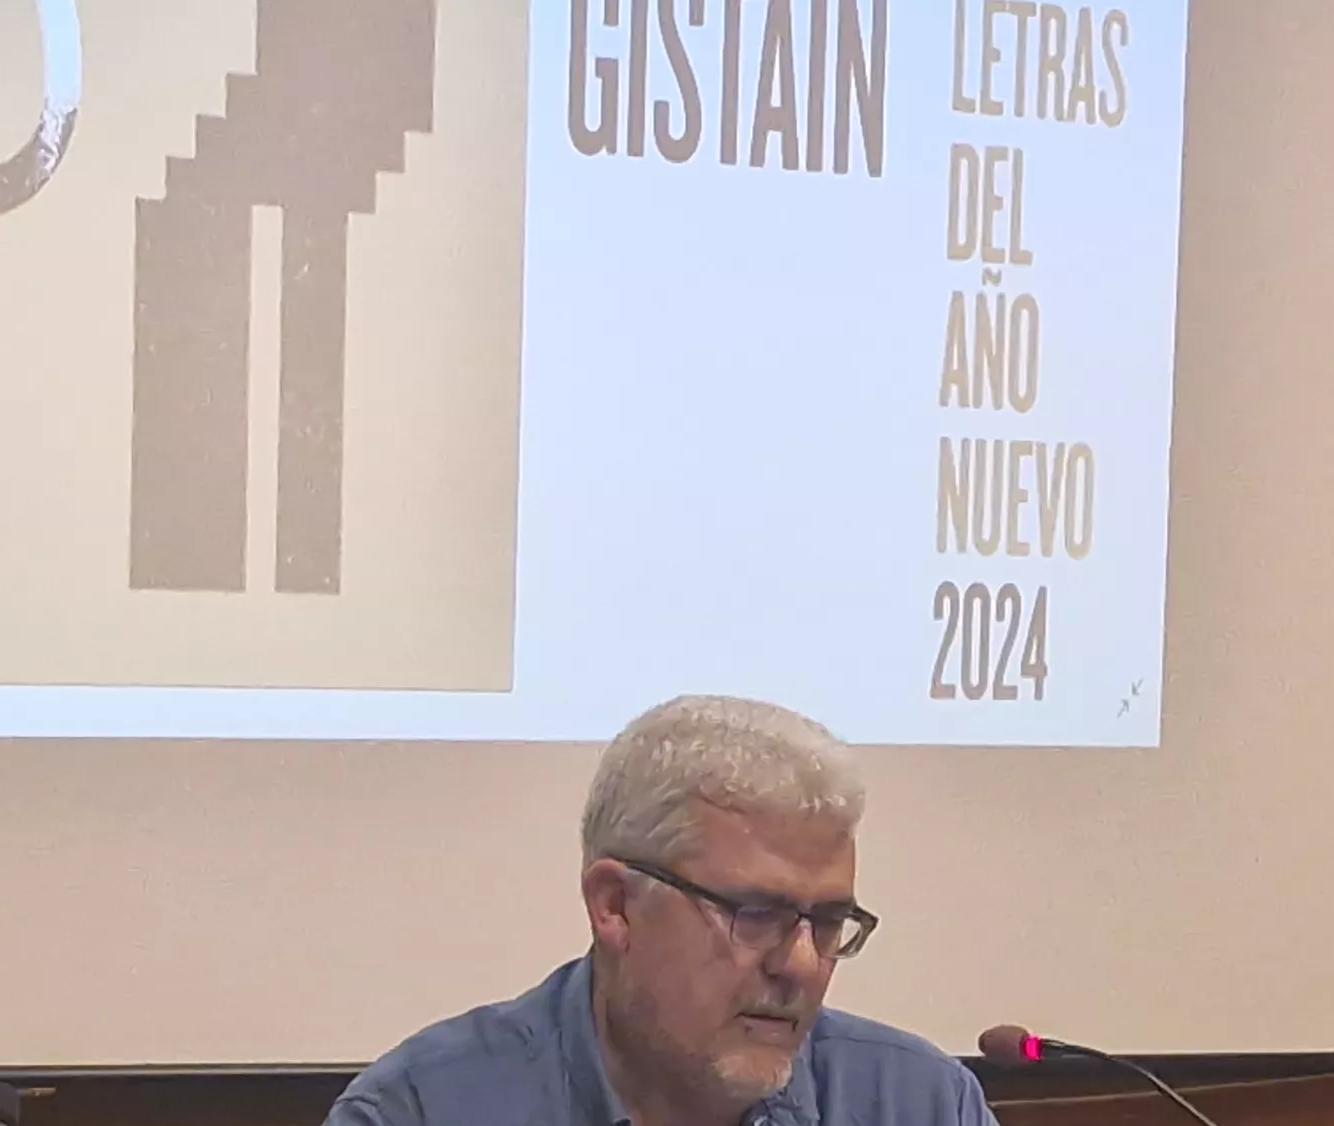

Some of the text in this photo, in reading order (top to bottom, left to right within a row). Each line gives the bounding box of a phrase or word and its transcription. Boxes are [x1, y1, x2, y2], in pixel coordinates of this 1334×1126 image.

[952, 0, 1128, 127] LETRAS
[947, 143, 1033, 265] DEL
[939, 268, 1040, 413] AÑO
[936, 436, 1095, 559] NUEVO
[929, 581, 1048, 700] 2024
